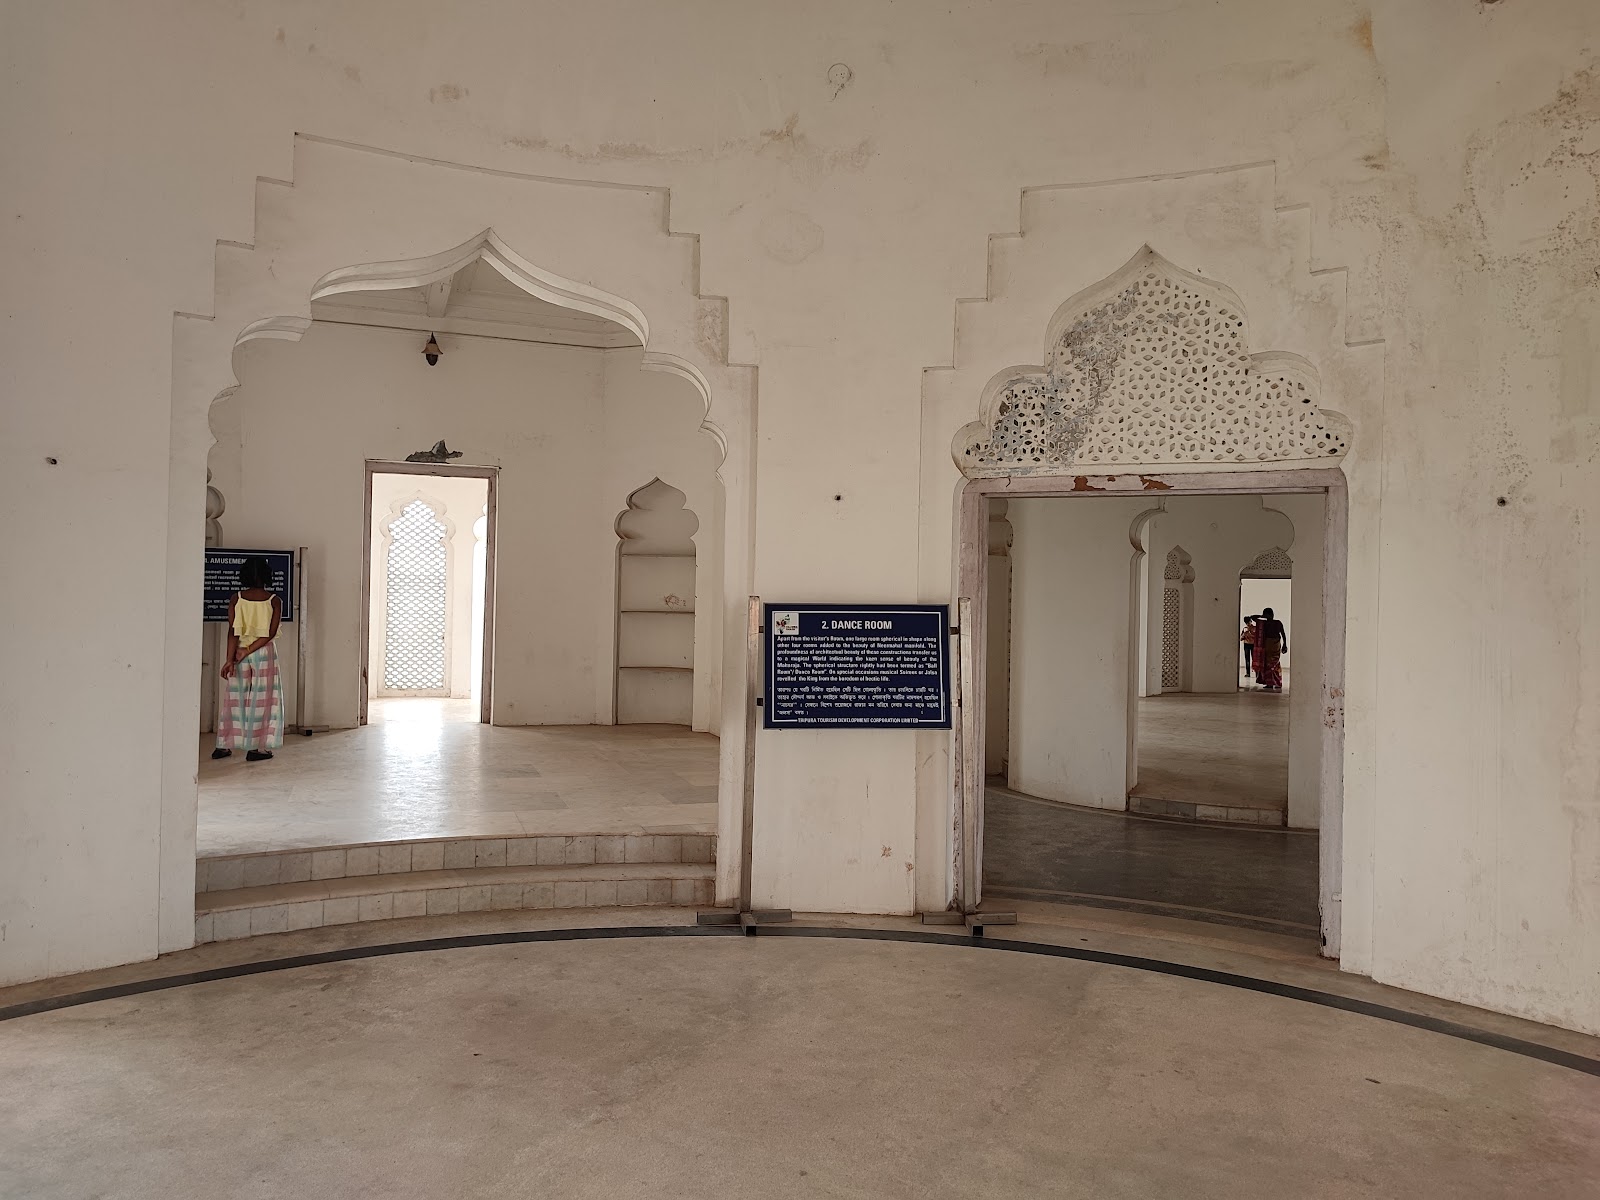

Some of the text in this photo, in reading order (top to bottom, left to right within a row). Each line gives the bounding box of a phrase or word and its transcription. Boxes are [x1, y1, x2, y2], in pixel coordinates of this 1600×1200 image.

[822, 620, 892, 630] 2. DANCE ROOM
